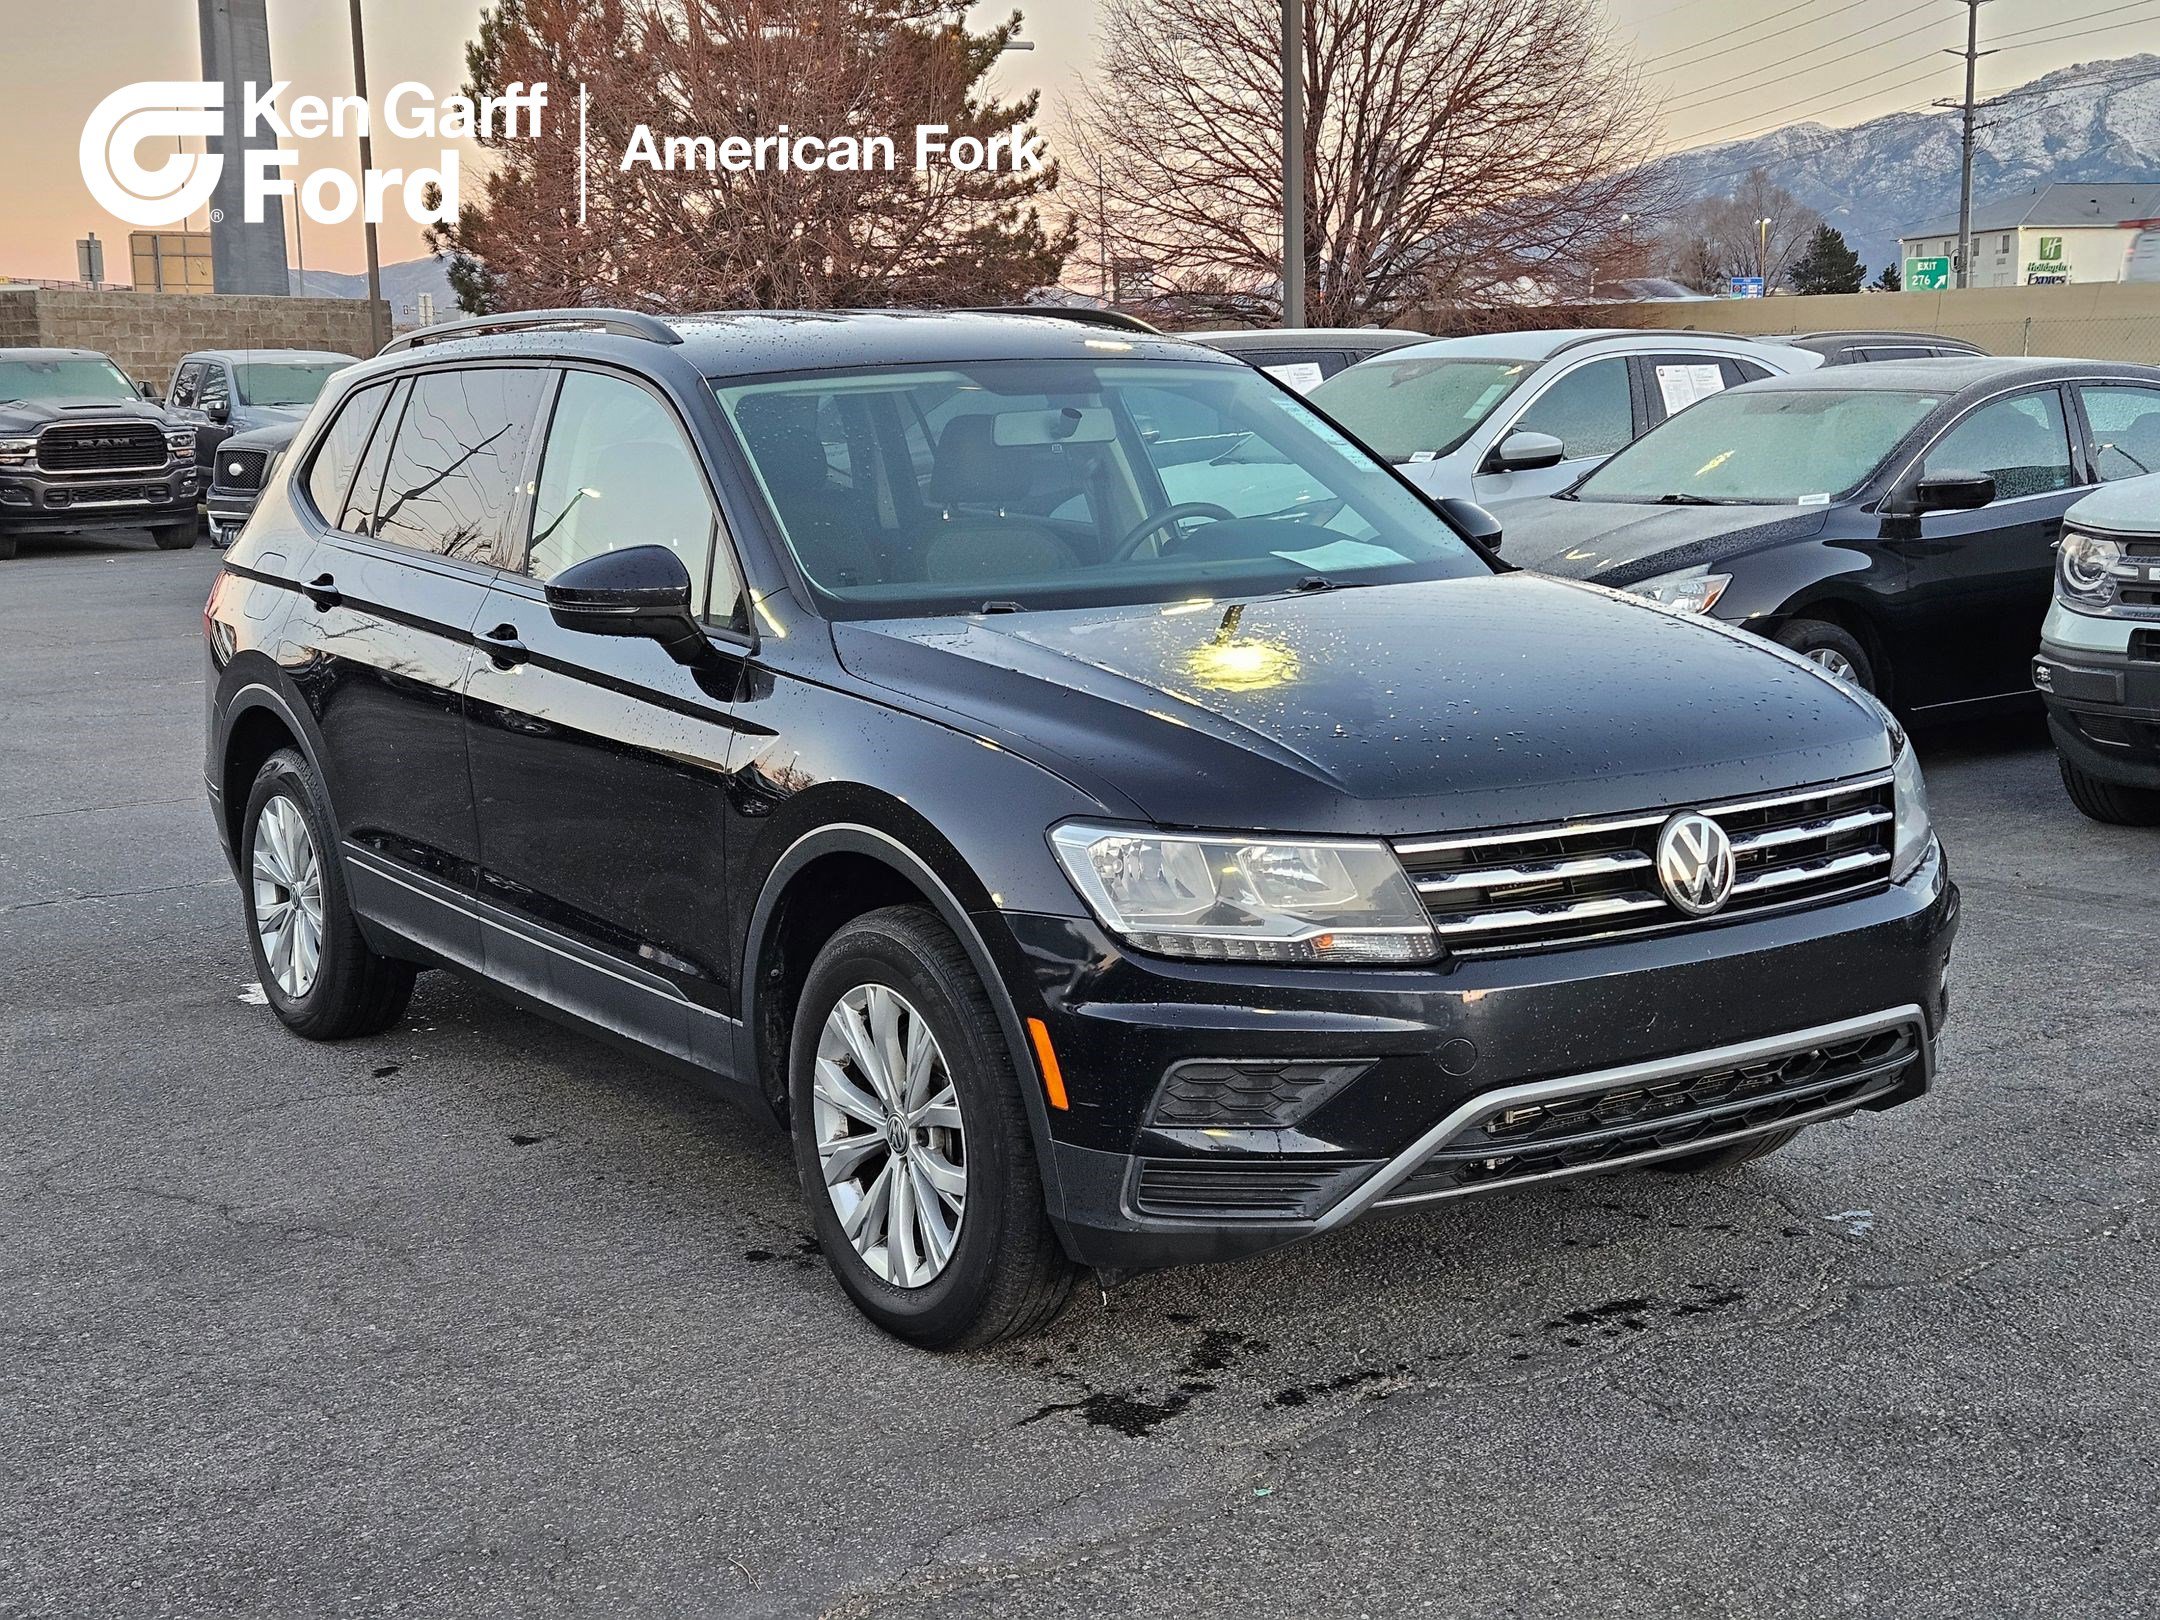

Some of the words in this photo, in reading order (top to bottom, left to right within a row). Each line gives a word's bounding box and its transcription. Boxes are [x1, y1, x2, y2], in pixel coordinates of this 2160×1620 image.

[1917, 261, 1937, 270] EXIT
[1911, 275, 1931, 286] 276
[77, 438, 130, 449] RAM
